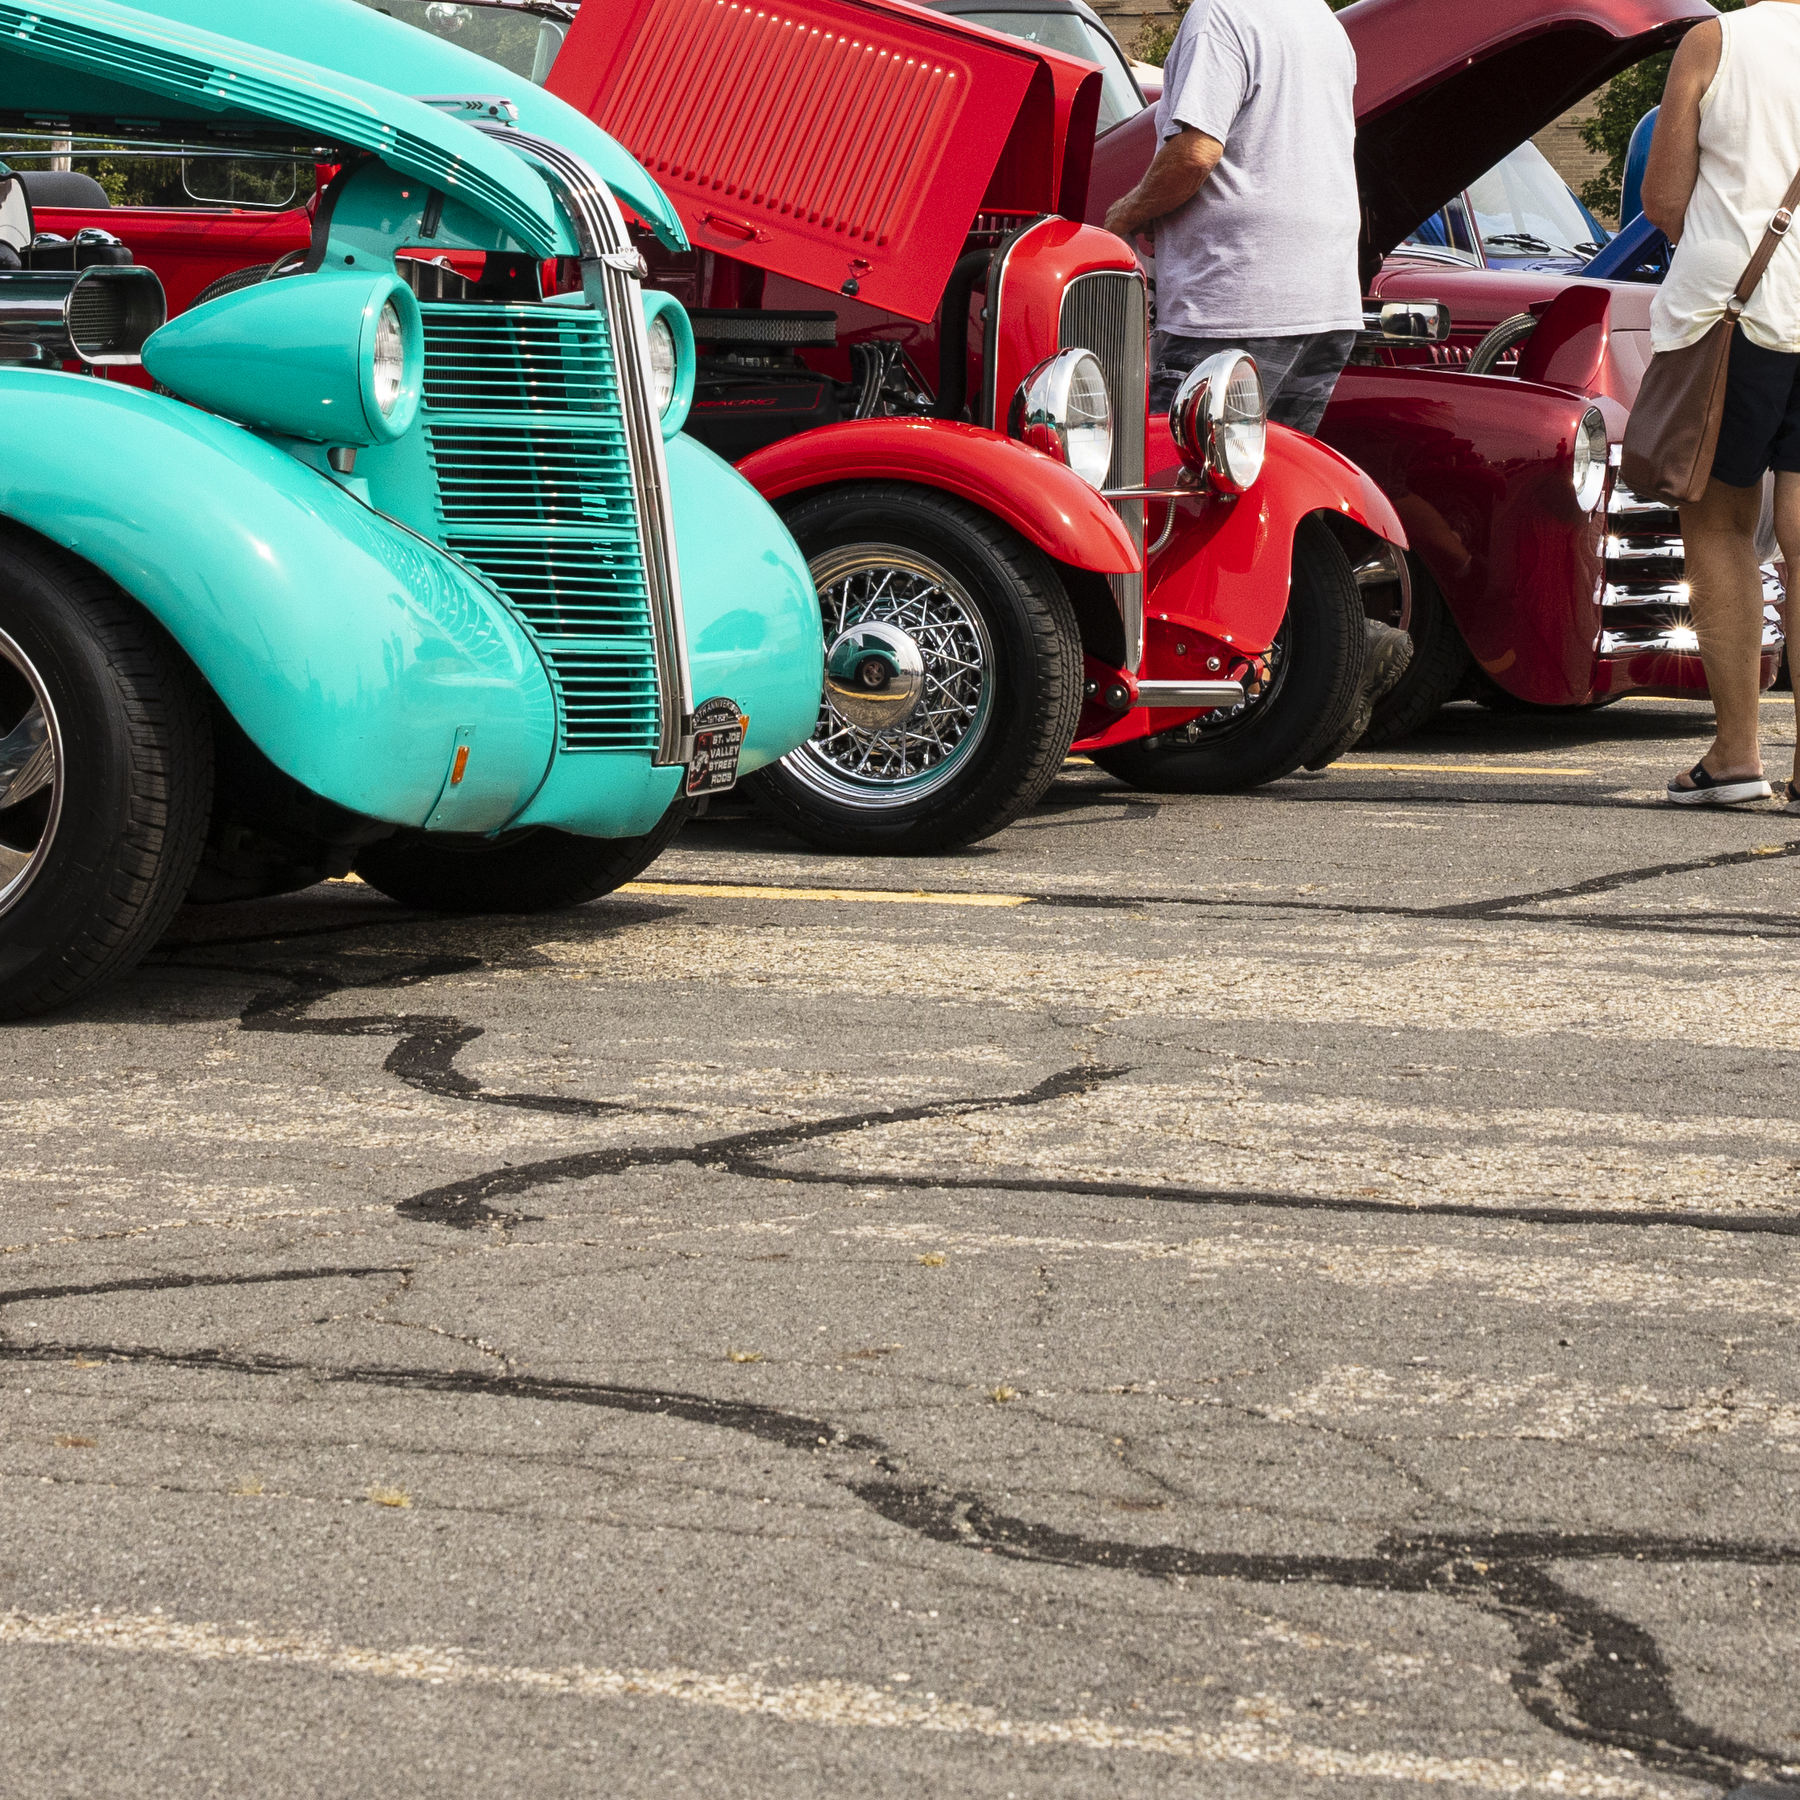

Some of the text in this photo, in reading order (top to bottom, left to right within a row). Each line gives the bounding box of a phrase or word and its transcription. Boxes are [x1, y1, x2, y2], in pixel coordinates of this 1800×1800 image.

[726, 732, 741, 743] JOE
[710, 745, 740, 759] VALLEY
[708, 759, 738, 771] STREET
[711, 773, 732, 785] RODS
